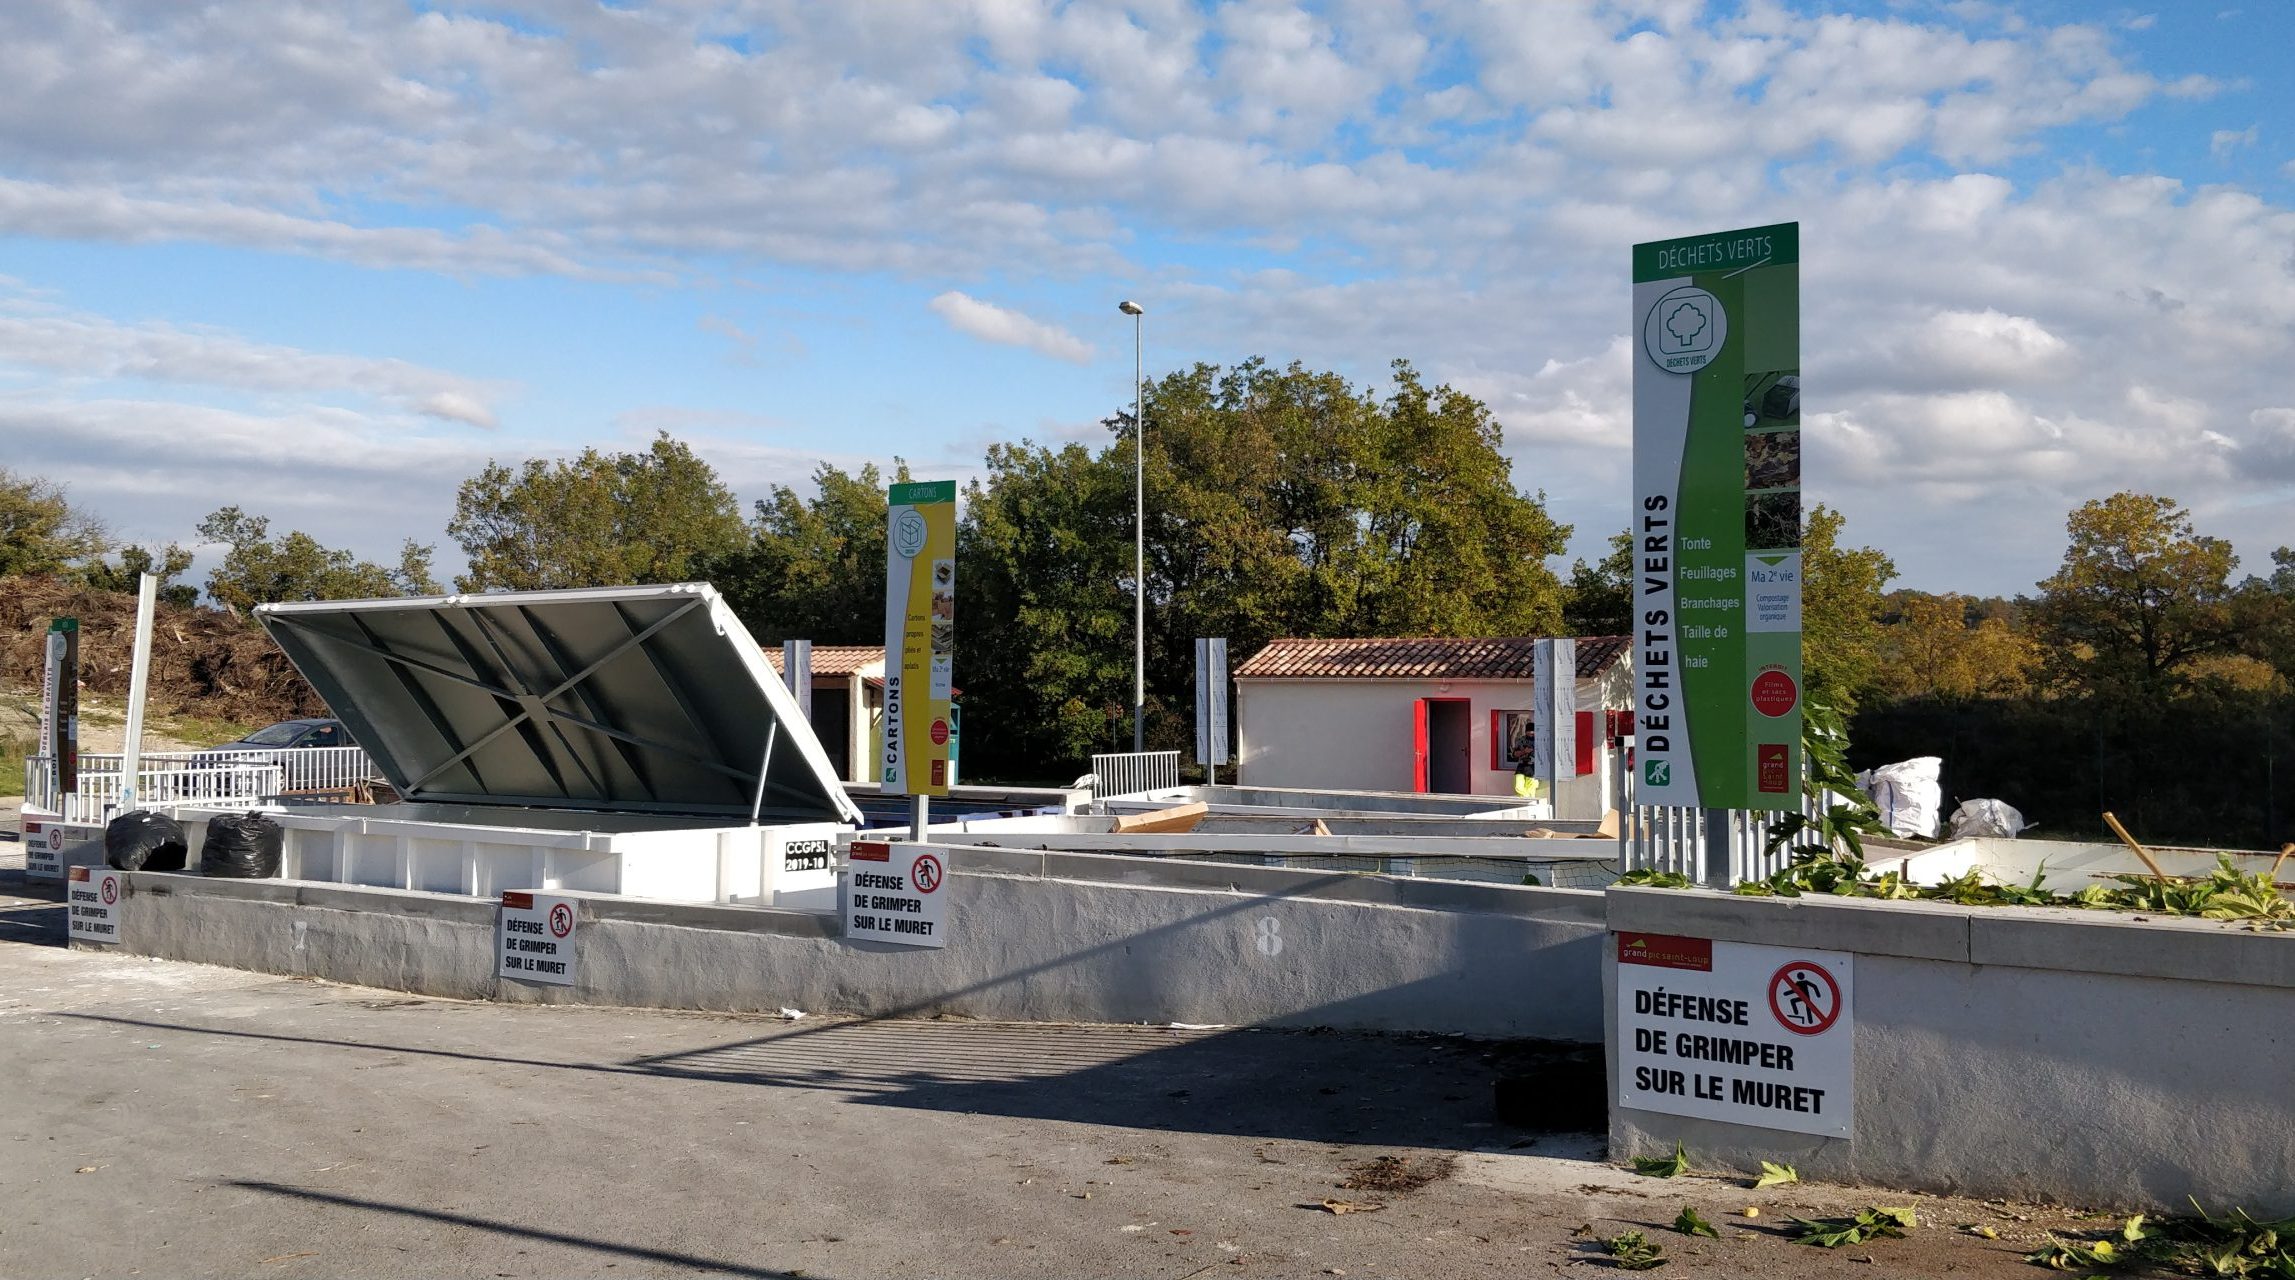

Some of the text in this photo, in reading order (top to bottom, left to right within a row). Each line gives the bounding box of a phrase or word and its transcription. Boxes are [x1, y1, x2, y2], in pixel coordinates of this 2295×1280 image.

[1659, 236, 1772, 270] DÉCHETS VERTS
[909, 487, 936, 498] CARTONS
[1681, 537, 1711, 550] Tonte
[1680, 566, 1736, 582] Feuillages
[1751, 571, 1765, 582] Ma
[1780, 570, 1794, 581] vie
[1681, 597, 1739, 612] Branchages
[1640, 495, 1669, 752] DÉCHETS VERTS
[1682, 625, 1728, 638] Taille de
[1686, 655, 1708, 668] haie
[887, 677, 899, 764] CARTONS
[786, 841, 826, 854] CCGPSL
[786, 857, 824, 870] 2019-10
[855, 871, 903, 890] DÉFENSE
[855, 894, 921, 913] DE GRIMPER
[72, 906, 107, 918] DE GRIMPER
[73, 921, 114, 934] SUR LE MURET
[507, 917, 543, 934] DÉFENSE
[854, 915, 933, 936] SUR LE MURET
[1257, 916, 1282, 956] 8
[506, 938, 556, 954] DE GRIMPER
[1624, 950, 1647, 958] grand
[1648, 952, 1661, 960] pic
[506, 956, 566, 974] SUR LE MURET
[1635, 986, 1748, 1026] DÉFENSE
[1635, 1028, 1794, 1071] DE GRIMPER
[1635, 1066, 1825, 1114] SUR LE MURET
